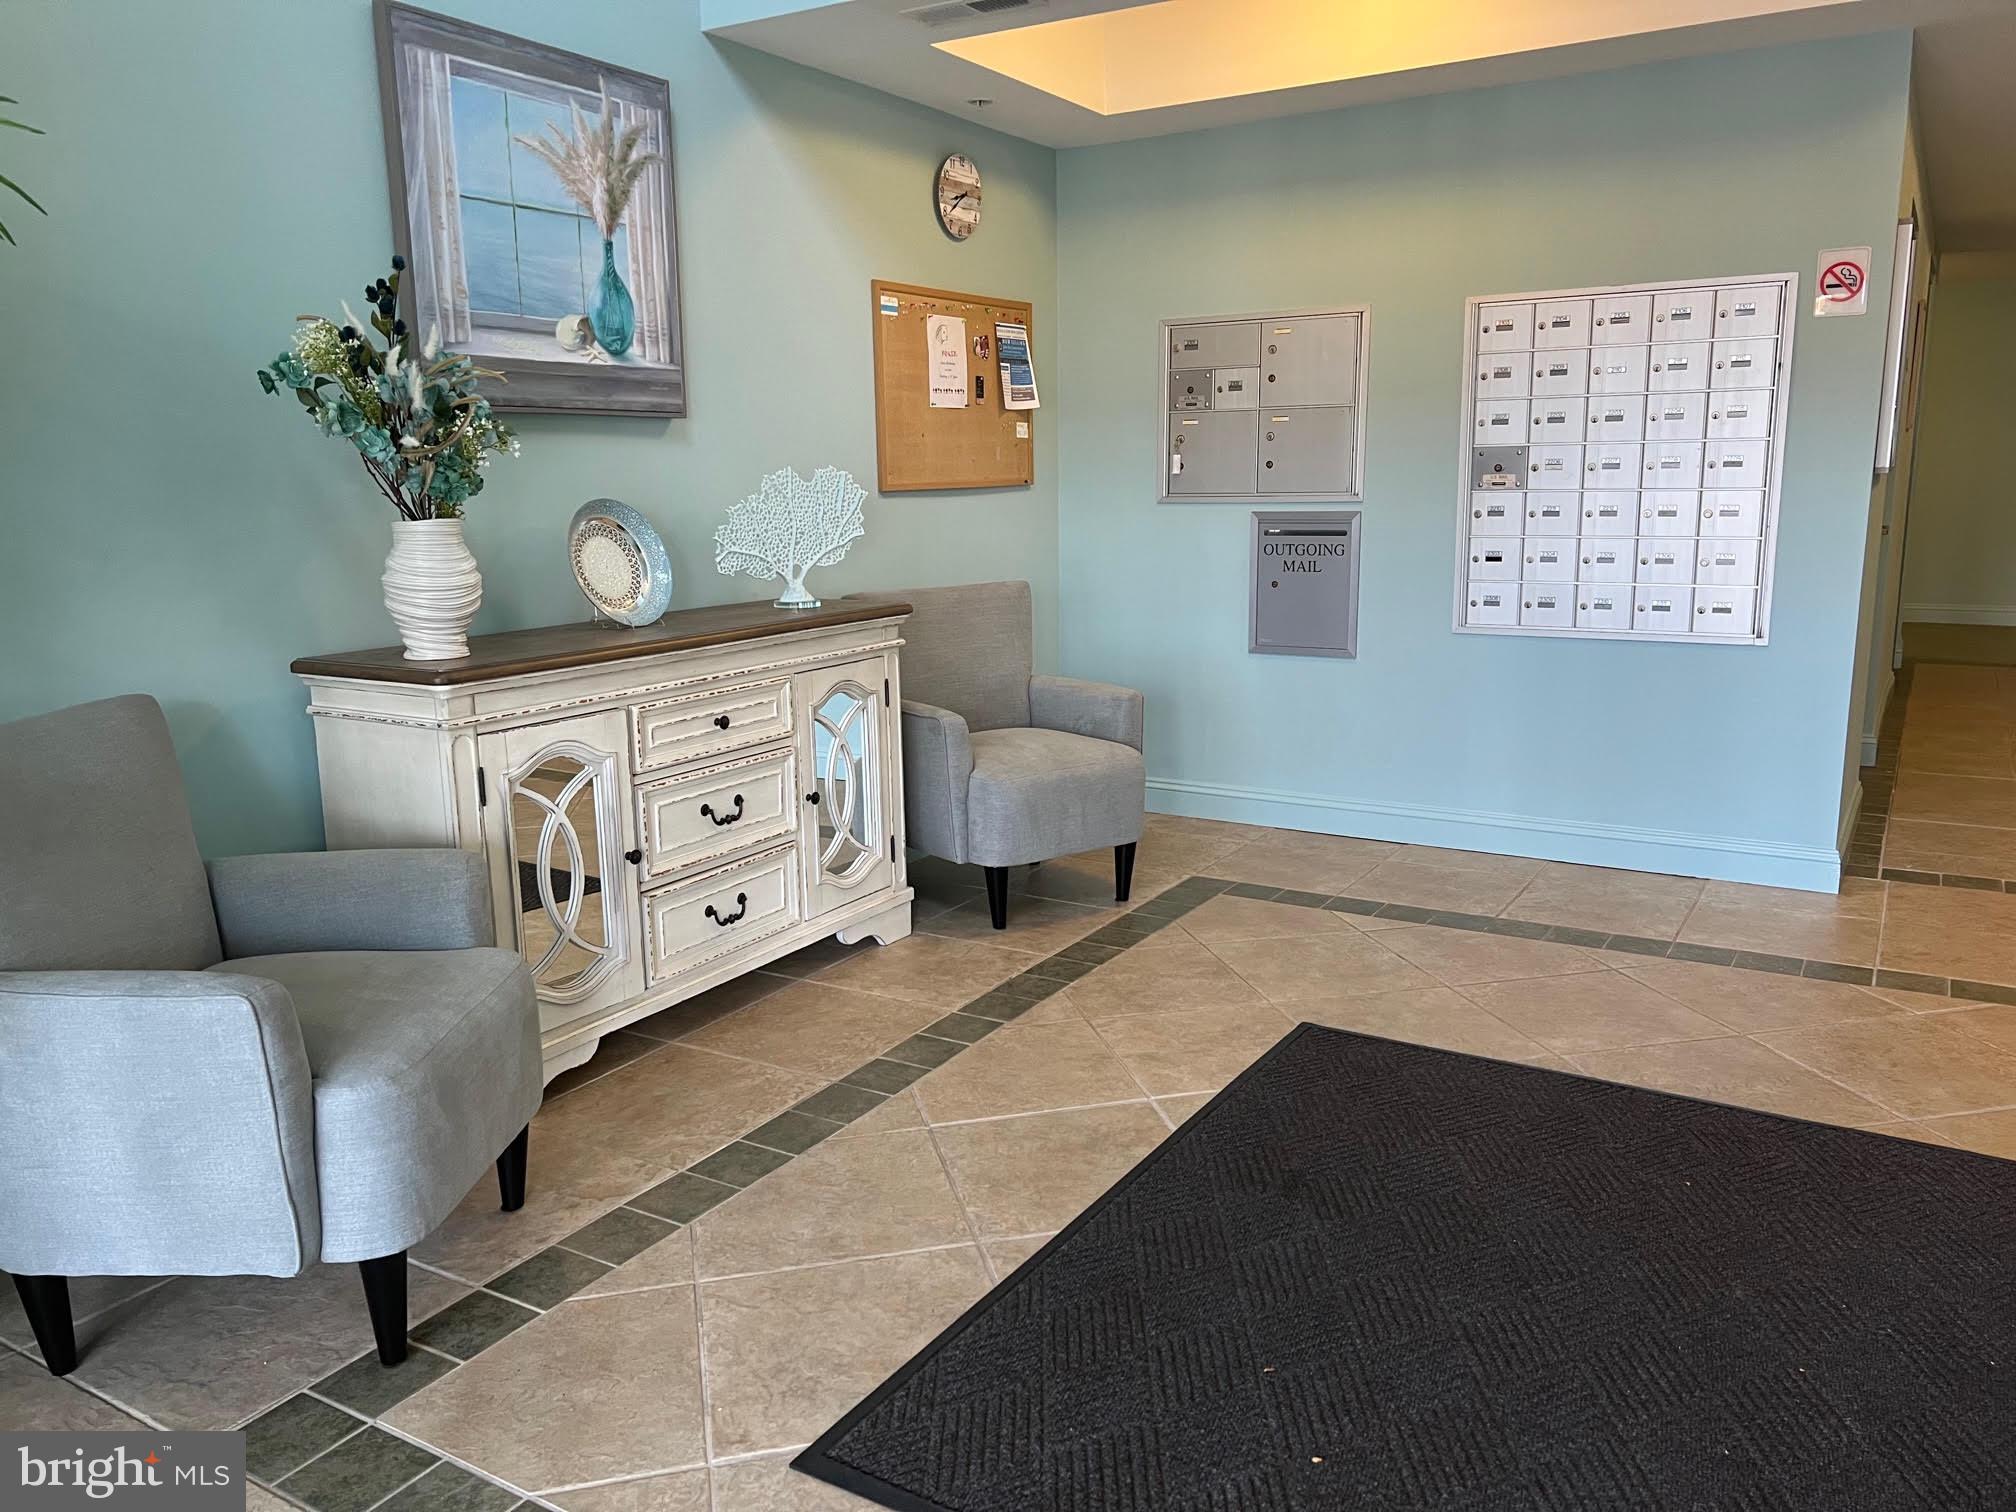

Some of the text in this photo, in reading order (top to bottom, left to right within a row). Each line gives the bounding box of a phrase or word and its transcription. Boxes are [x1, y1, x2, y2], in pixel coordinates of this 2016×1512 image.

[950, 158, 955, 169] 11
[943, 169, 950, 181] 10
[1263, 543, 1345, 557] OUTGOING
[1282, 560, 1323, 573] MAIL
